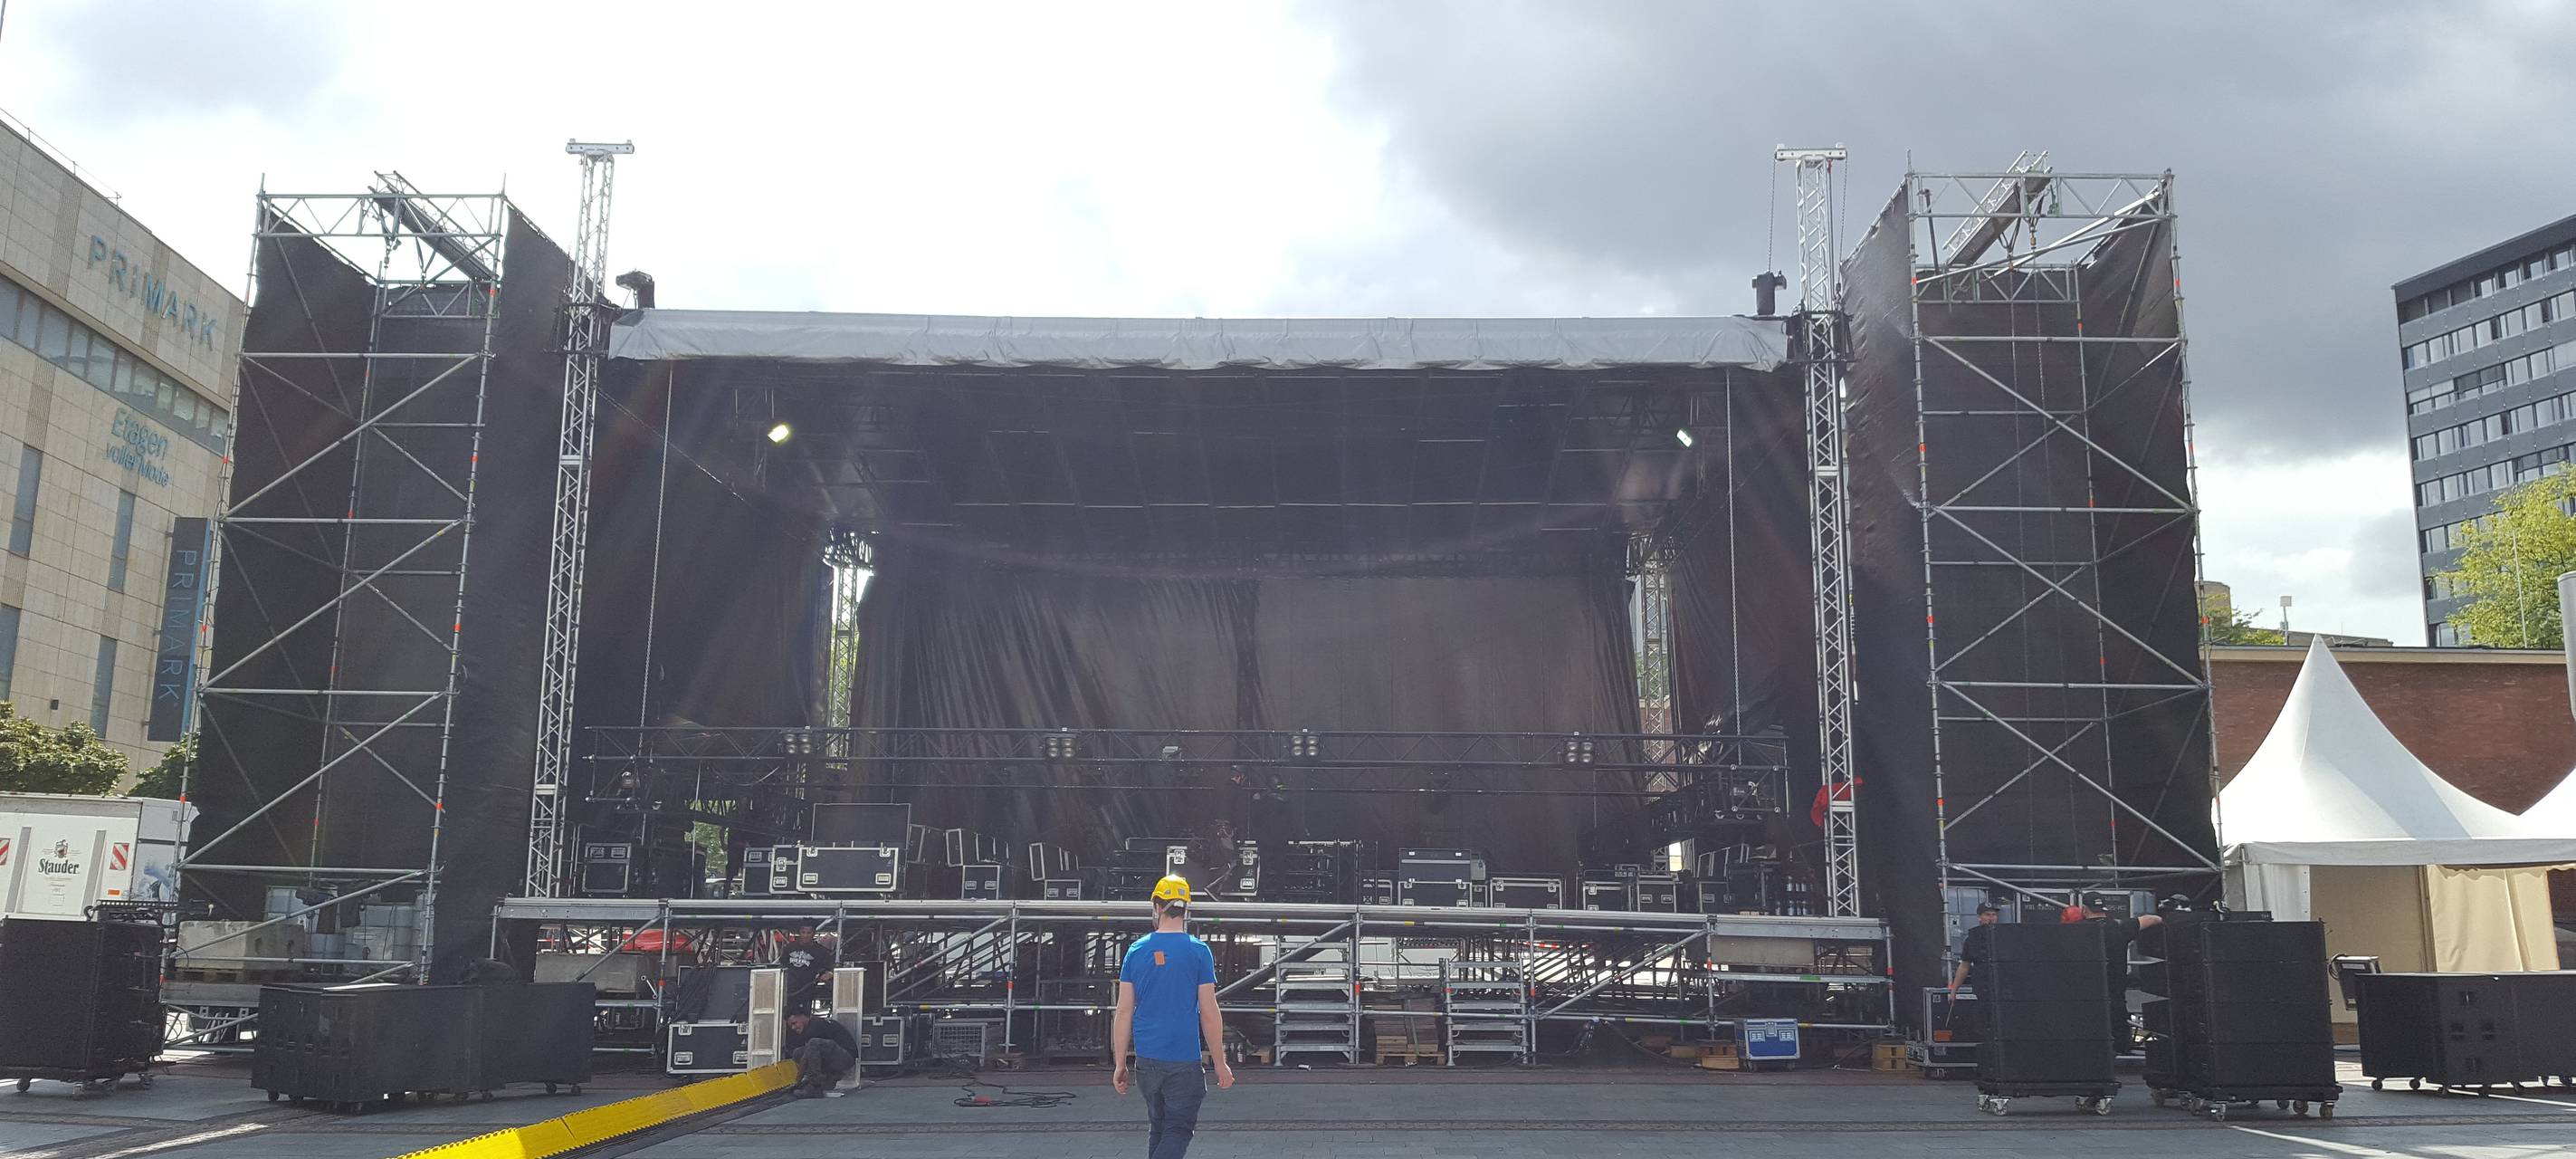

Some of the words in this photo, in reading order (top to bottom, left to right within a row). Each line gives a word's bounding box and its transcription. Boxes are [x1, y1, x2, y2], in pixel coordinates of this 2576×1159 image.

[88, 235, 217, 351] PRIMARK
[111, 407, 167, 461] Etagen
[158, 550, 197, 700] PRIMARK
[38, 857, 81, 876] Stauder
